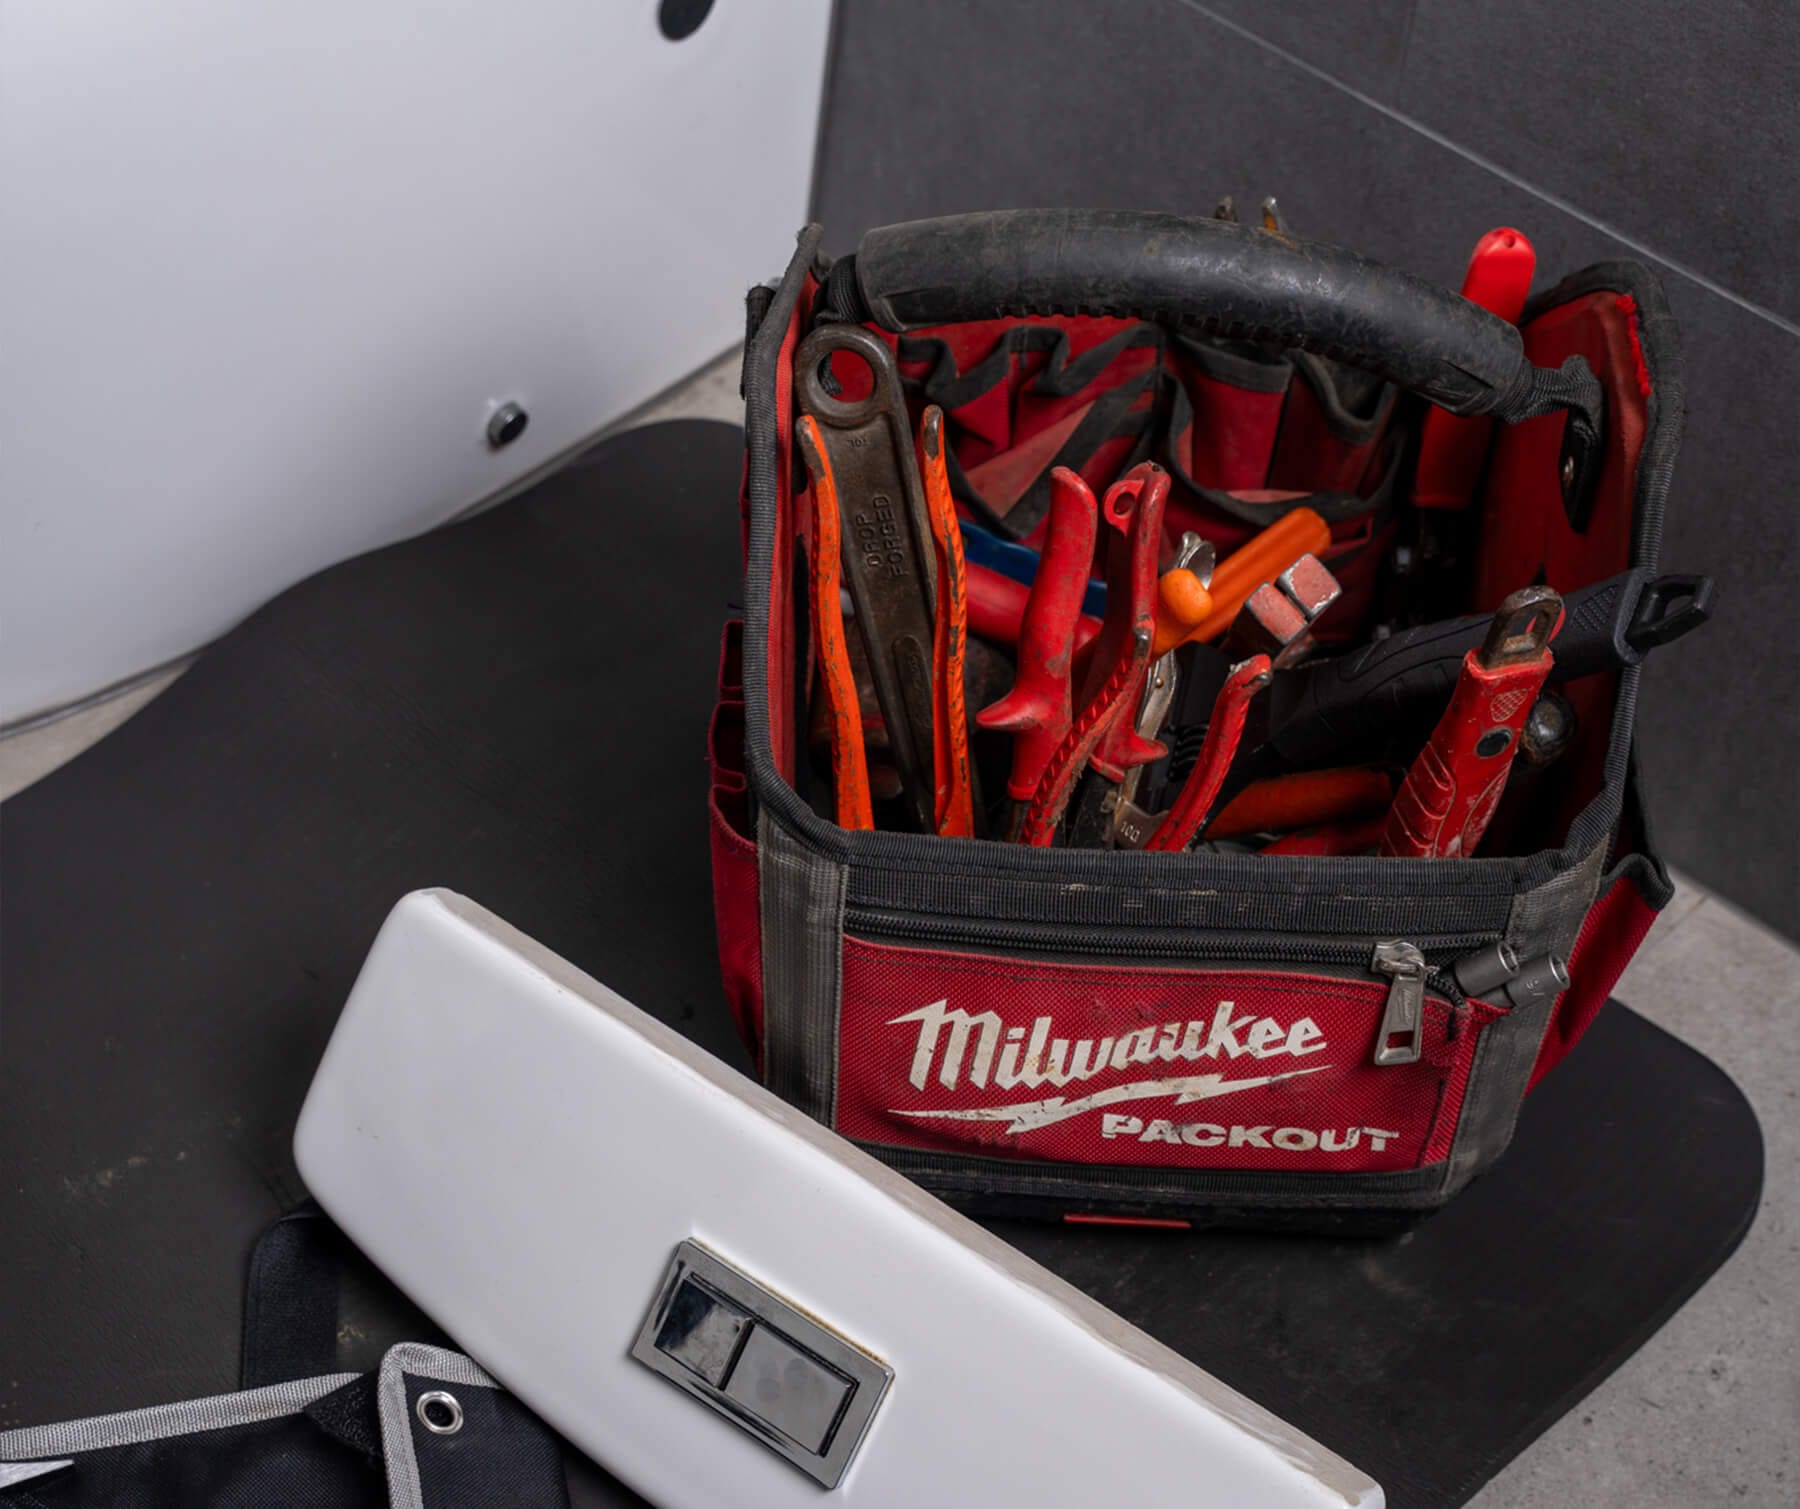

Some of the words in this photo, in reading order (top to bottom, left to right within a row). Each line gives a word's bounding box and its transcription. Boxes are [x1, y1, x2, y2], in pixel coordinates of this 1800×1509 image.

[855, 512, 881, 567] DROP
[873, 495, 907, 577] FORGED
[886, 999, 1327, 1091] Milwaukee
[1101, 1113, 1399, 1152] PACKOUT
